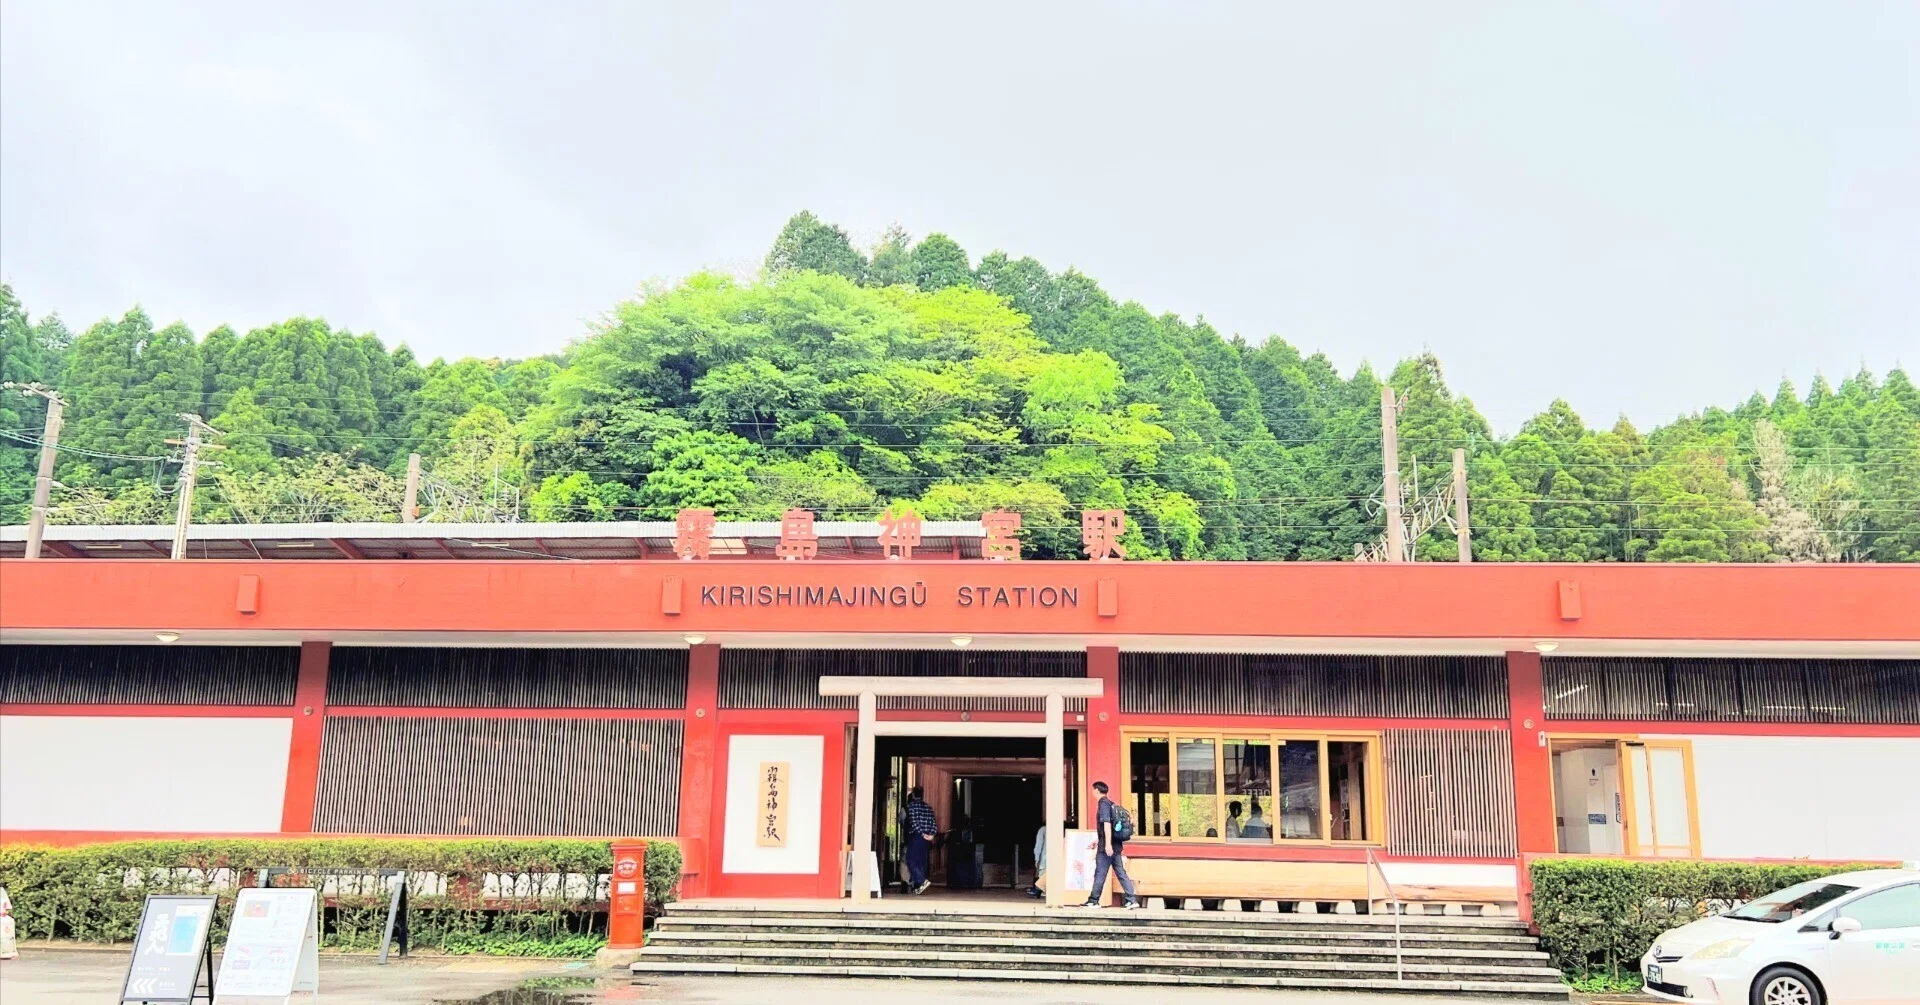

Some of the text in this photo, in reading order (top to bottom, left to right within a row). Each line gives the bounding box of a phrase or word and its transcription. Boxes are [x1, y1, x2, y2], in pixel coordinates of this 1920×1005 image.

[673, 508, 1127, 560] 霧島神宮駅
[701, 581, 1079, 608] KIRISHIMAJINGŪ STATION
